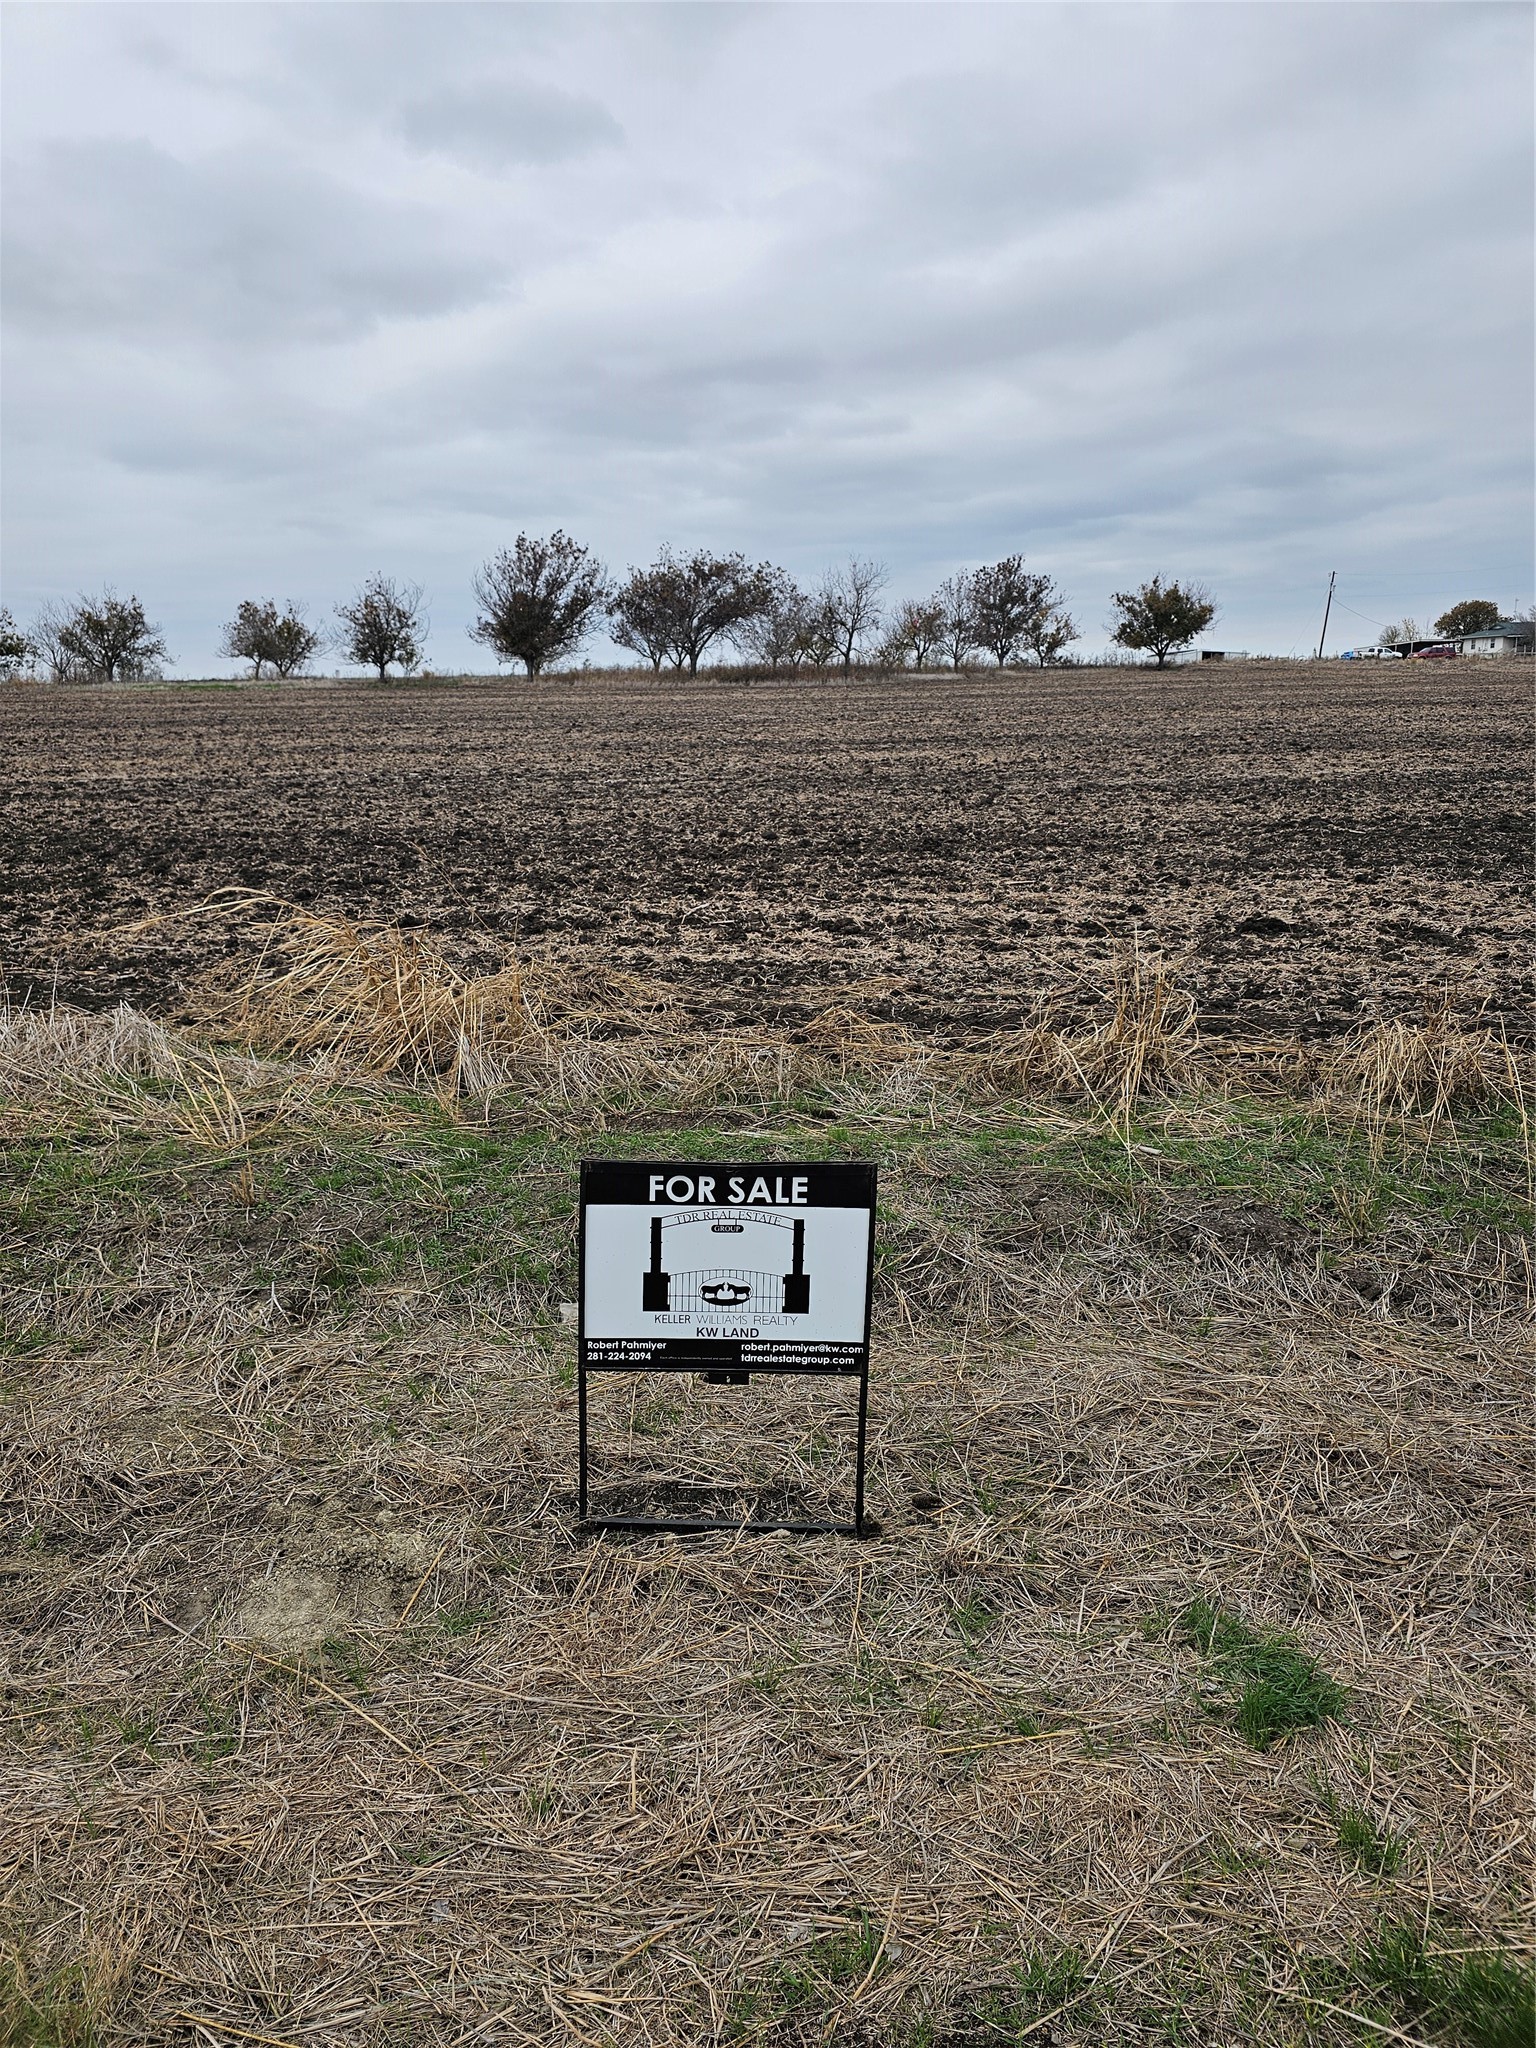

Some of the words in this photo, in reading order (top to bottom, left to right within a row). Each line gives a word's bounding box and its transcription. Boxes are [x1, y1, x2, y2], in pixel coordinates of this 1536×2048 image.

[649, 1175, 715, 1203] FOR
[728, 1176, 808, 1204] SALE
[674, 1212, 699, 1225] TDR
[703, 1210, 735, 1220] REAL
[738, 1211, 782, 1226] ESTATE
[654, 1314, 691, 1324] KELLER
[696, 1315, 748, 1325] WILLIAMS
[753, 1315, 799, 1326] REALTY
[696, 1327, 718, 1337] KW
[722, 1327, 760, 1338] LAND
[587, 1340, 619, 1349] Robert
[621, 1340, 667, 1351] Pahmiyer
[741, 1342, 864, 1354] robert.pahmiyer@kw.com
[586, 1352, 651, 1361] 281-224-2094
[740, 1353, 855, 1366] tdrrealestategroup.com
